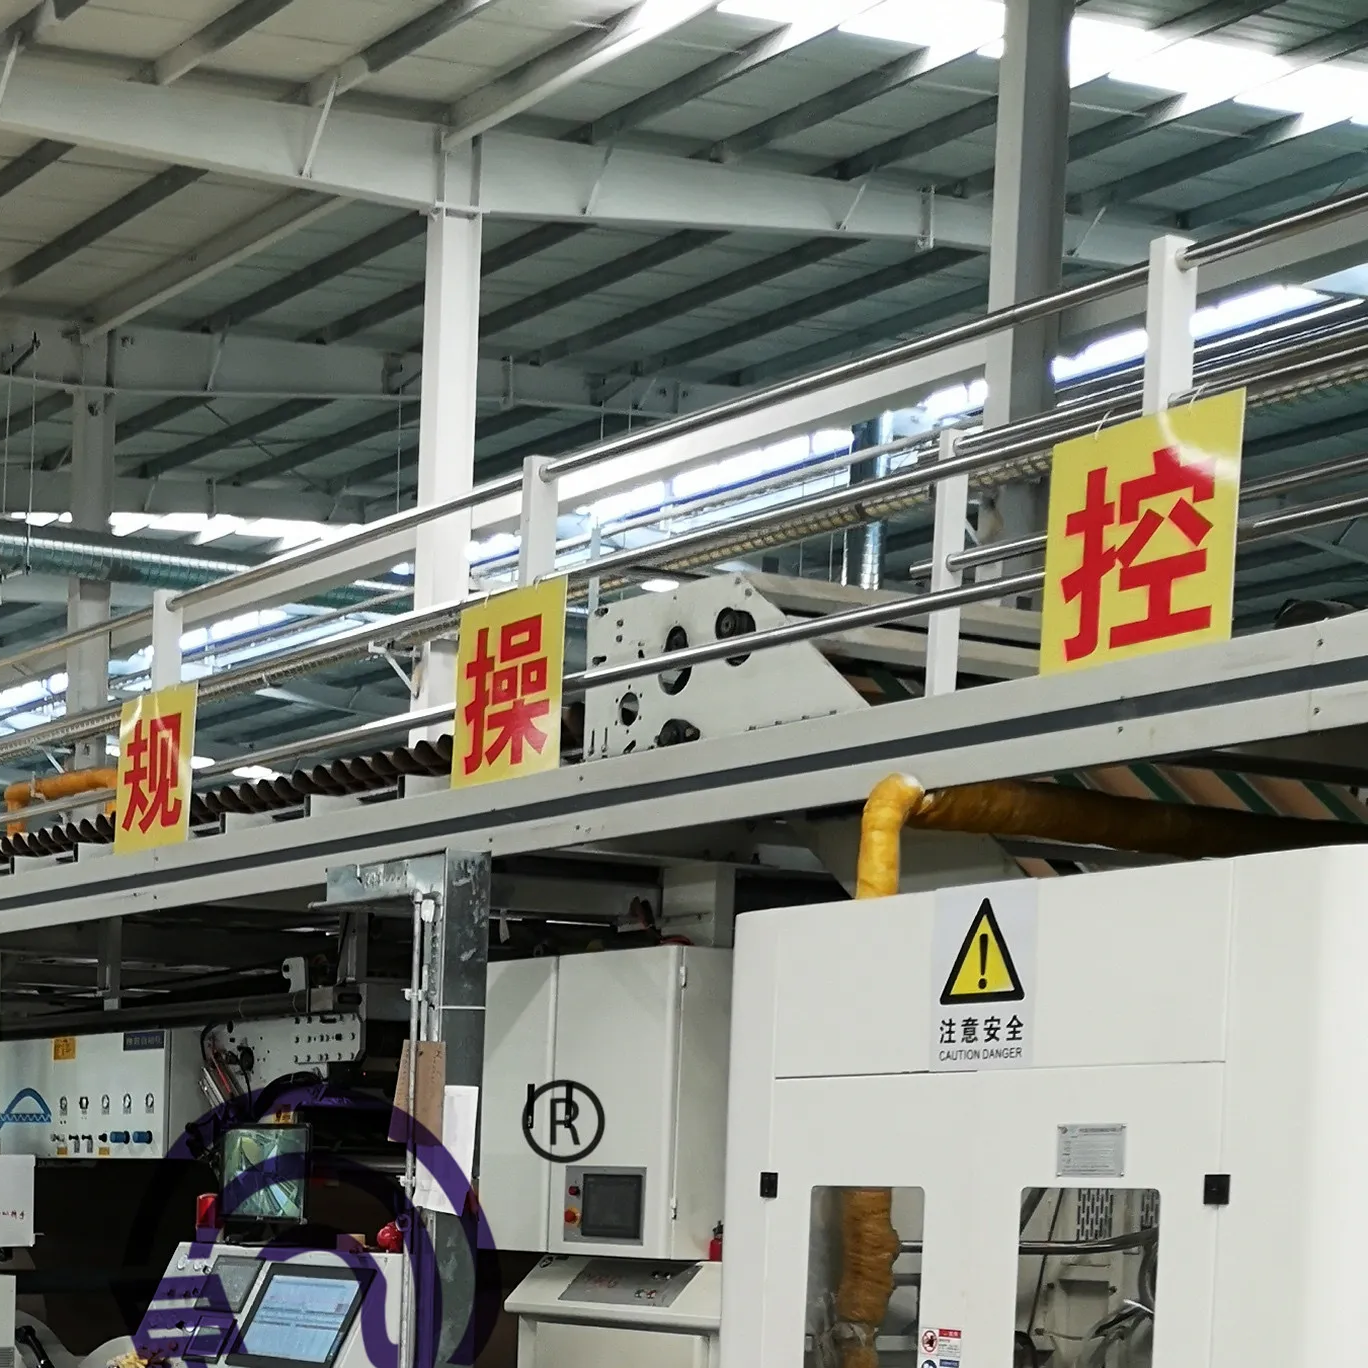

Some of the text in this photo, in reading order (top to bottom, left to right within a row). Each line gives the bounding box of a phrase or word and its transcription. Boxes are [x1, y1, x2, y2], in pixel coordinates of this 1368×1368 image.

[1061, 446, 1216, 661] 控
[464, 614, 549, 775] 操
[122, 713, 182, 833] 规
[938, 1046, 1023, 1062] CAUTION DANGER
[939, 1015, 1024, 1044] 注意安全
